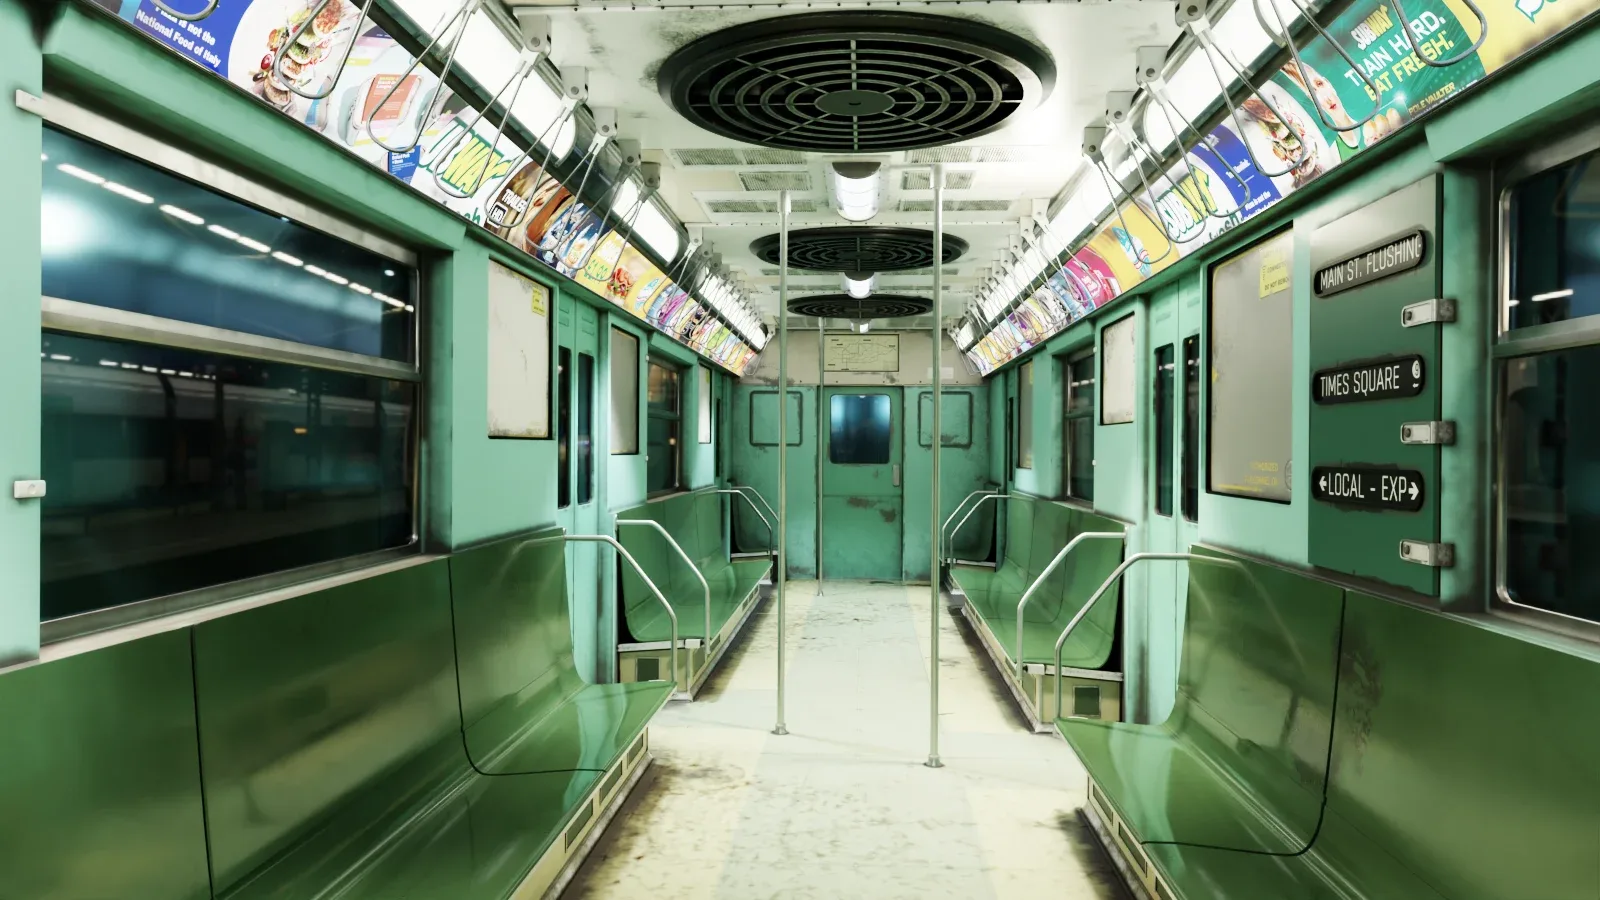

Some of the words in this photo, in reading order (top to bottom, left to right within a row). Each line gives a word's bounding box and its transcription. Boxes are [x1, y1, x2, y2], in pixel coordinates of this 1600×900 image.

[136, 9, 174, 39] National
[173, 31, 195, 51] Food
[193, 45, 204, 56] of
[202, 49, 221, 68] Italy
[187, 23, 203, 38] not
[201, 30, 216, 46] the
[1351, 4, 1393, 50] SUBWAY
[1363, 71, 1393, 101] EAT
[1424, 82, 1456, 106] VAULTER
[1320, 263, 1344, 291] MAIN
[1347, 257, 1362, 281] ST.
[1366, 235, 1422, 275] FLUSHING
[1320, 373, 1350, 397] TIMES
[1353, 365, 1400, 397] SQUARE
[1328, 472, 1365, 499] LOCAL
[1381, 475, 1407, 502] EXP
